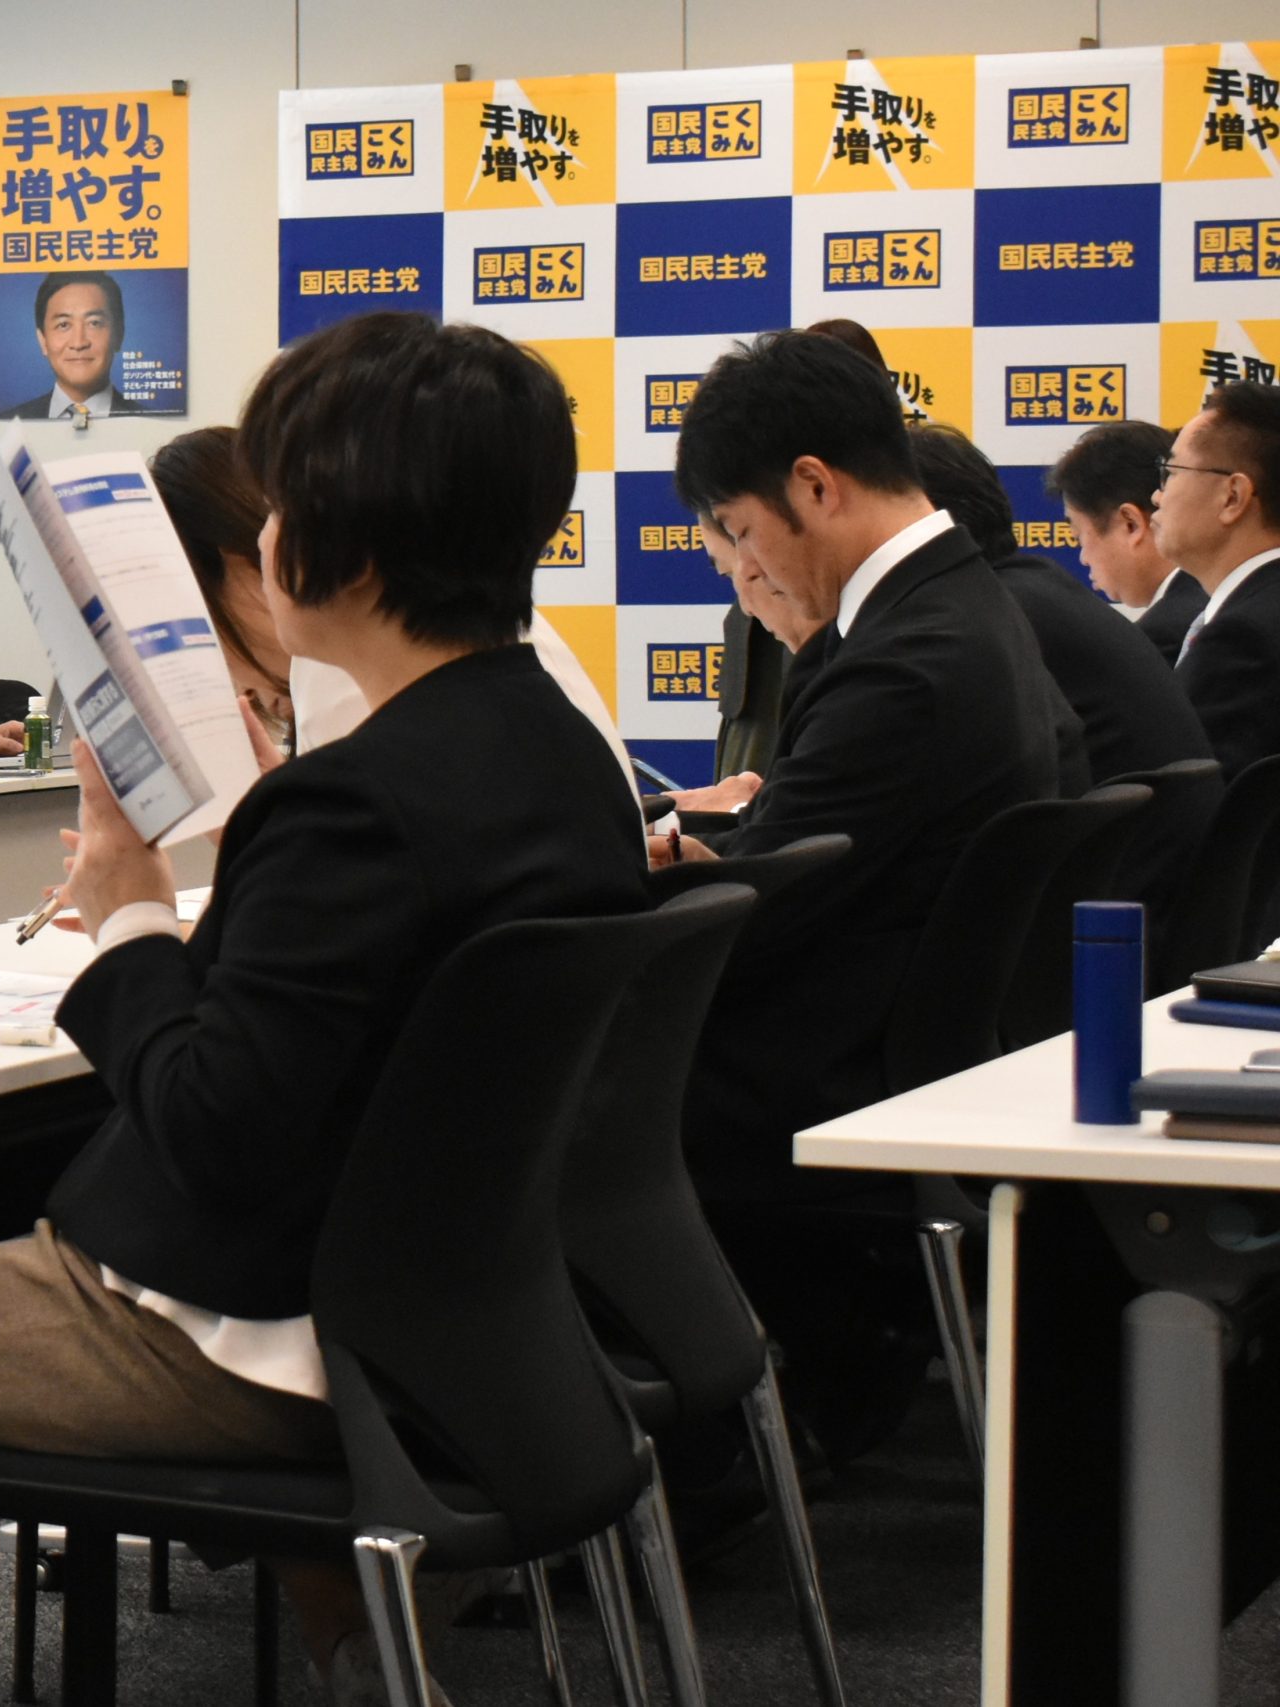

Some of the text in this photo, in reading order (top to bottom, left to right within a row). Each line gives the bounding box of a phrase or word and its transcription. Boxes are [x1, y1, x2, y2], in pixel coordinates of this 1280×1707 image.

[1203, 67, 1280, 111] 手取
[831, 83, 937, 130] 手取りを
[1013, 93, 1066, 121] 国民
[1078, 91, 1119, 113] こく
[480, 103, 580, 147] 手取りを
[652, 110, 701, 137] 国民
[713, 107, 751, 128] こく
[1076, 117, 1121, 137] みん
[2, 102, 164, 162] 手取りを
[310, 128, 357, 154] 国民
[367, 126, 405, 146] こく
[711, 133, 754, 152] みん
[1013, 121, 1066, 141] 民主党
[1205, 112, 1280, 152] 増や
[652, 137, 701, 156] 民主党
[833, 127, 932, 165] 増やす。
[311, 155, 358, 173] 民主党
[366, 150, 408, 169] みん
[482, 146, 575, 182] 増やす。
[1, 165, 162, 224] 増やす。
[3, 227, 159, 263] 国民民主党
[828, 237, 879, 264] 国民
[891, 236, 931, 257] こく
[1199, 226, 1254, 254] 国民
[478, 252, 526, 278] 国民
[537, 250, 575, 270] こく
[639, 252, 767, 282] 国民民主党
[999, 241, 1134, 271] 国民民主党
[1199, 254, 1254, 274] 民主党
[299, 267, 420, 295] 国民民主党
[828, 264, 880, 285] 民主党
[889, 261, 933, 281] みん
[478, 279, 526, 298] 民主党
[535, 274, 577, 294] みん
[1010, 372, 1063, 399] 国民
[1075, 371, 1116, 392] こく
[1010, 400, 1063, 418] 民主党
[1073, 396, 1118, 416] みん
[652, 650, 701, 674] 国民
[653, 676, 702, 694] 民主党
